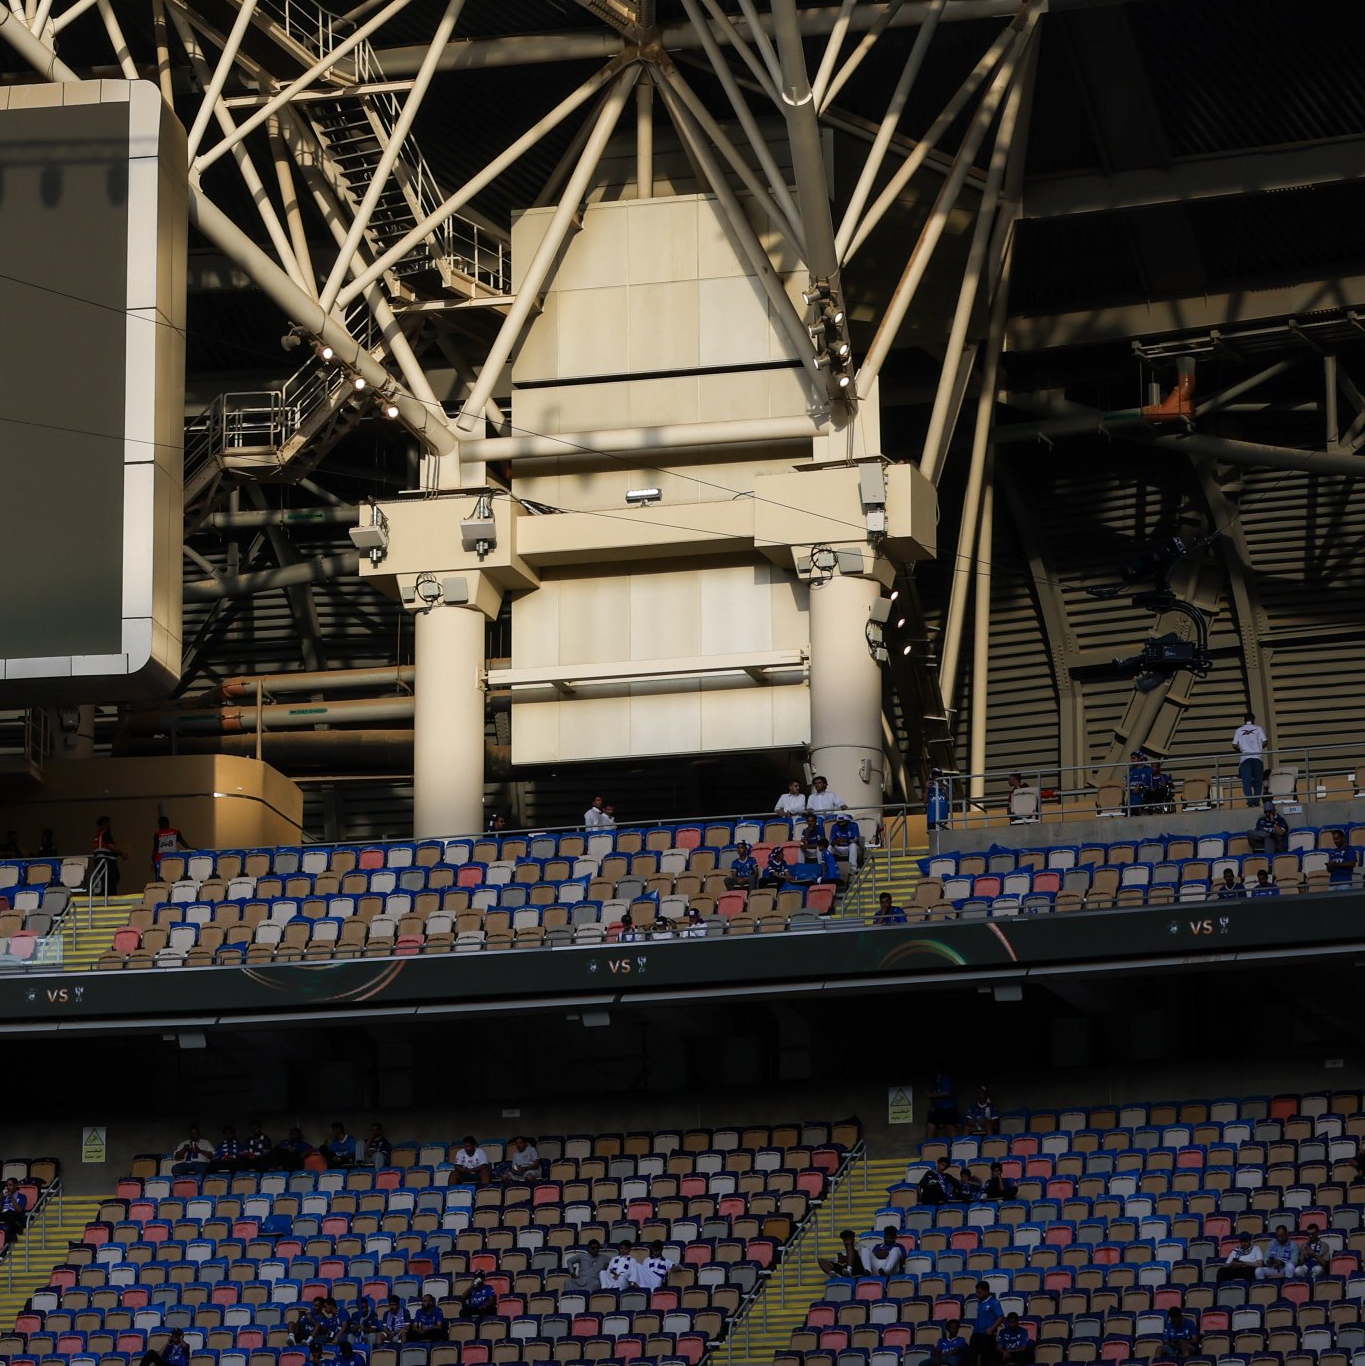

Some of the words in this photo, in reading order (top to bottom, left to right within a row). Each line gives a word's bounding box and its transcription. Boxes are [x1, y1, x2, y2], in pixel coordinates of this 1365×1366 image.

[1190, 920, 1213, 935] VS
[608, 959, 630, 973] VS
[47, 988, 68, 1002] VS
